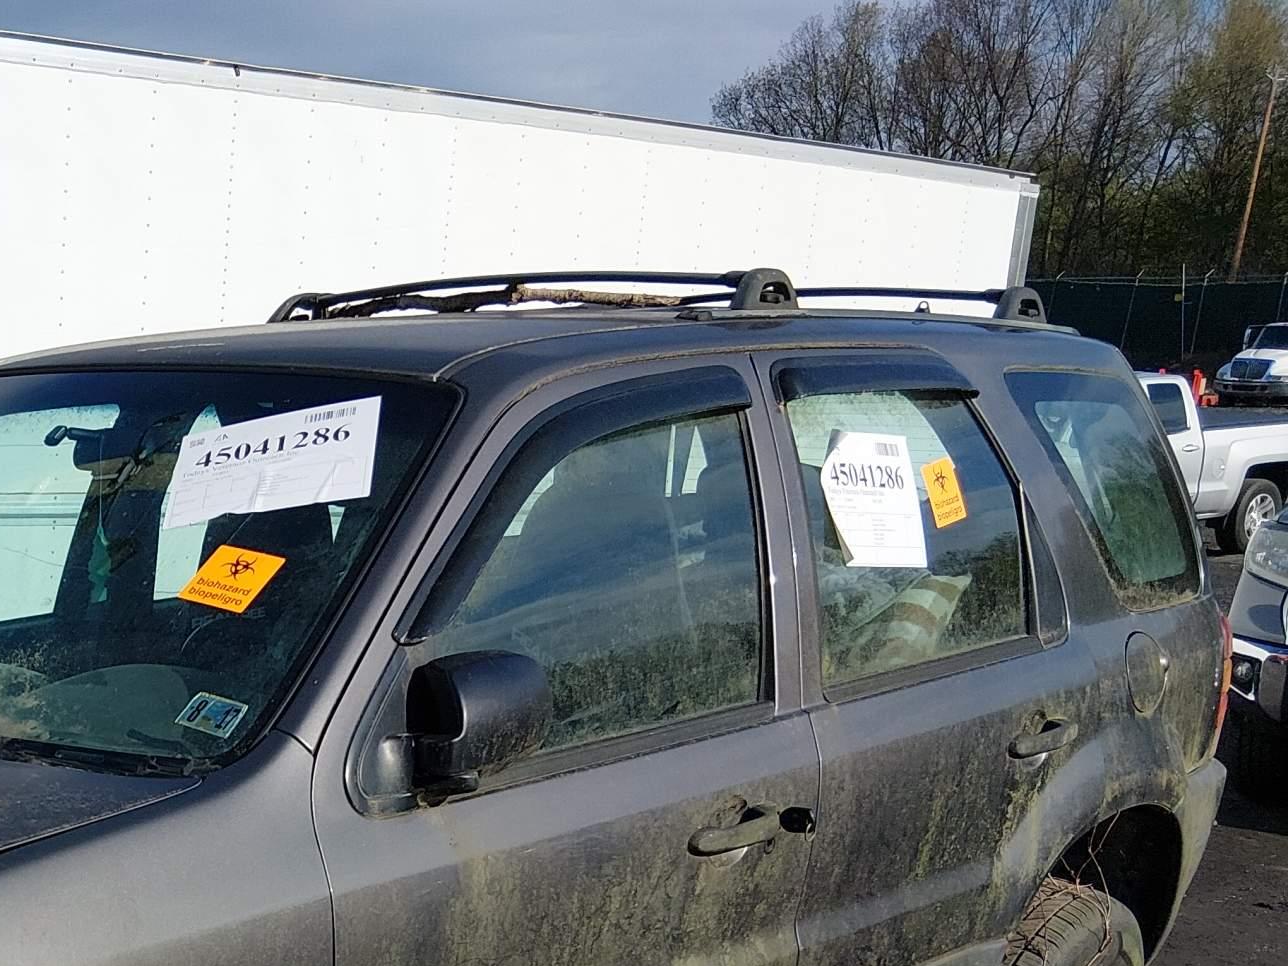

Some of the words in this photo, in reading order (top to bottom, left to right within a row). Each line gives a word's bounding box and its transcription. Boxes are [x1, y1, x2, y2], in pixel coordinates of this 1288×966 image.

[195, 423, 353, 467] 45041286
[830, 461, 905, 489] 45041286
[188, 585, 243, 606] biopeligro
[196, 577, 252, 596] biohazard
[186, 699, 210, 722] 8
[215, 706, 242, 730] 17
